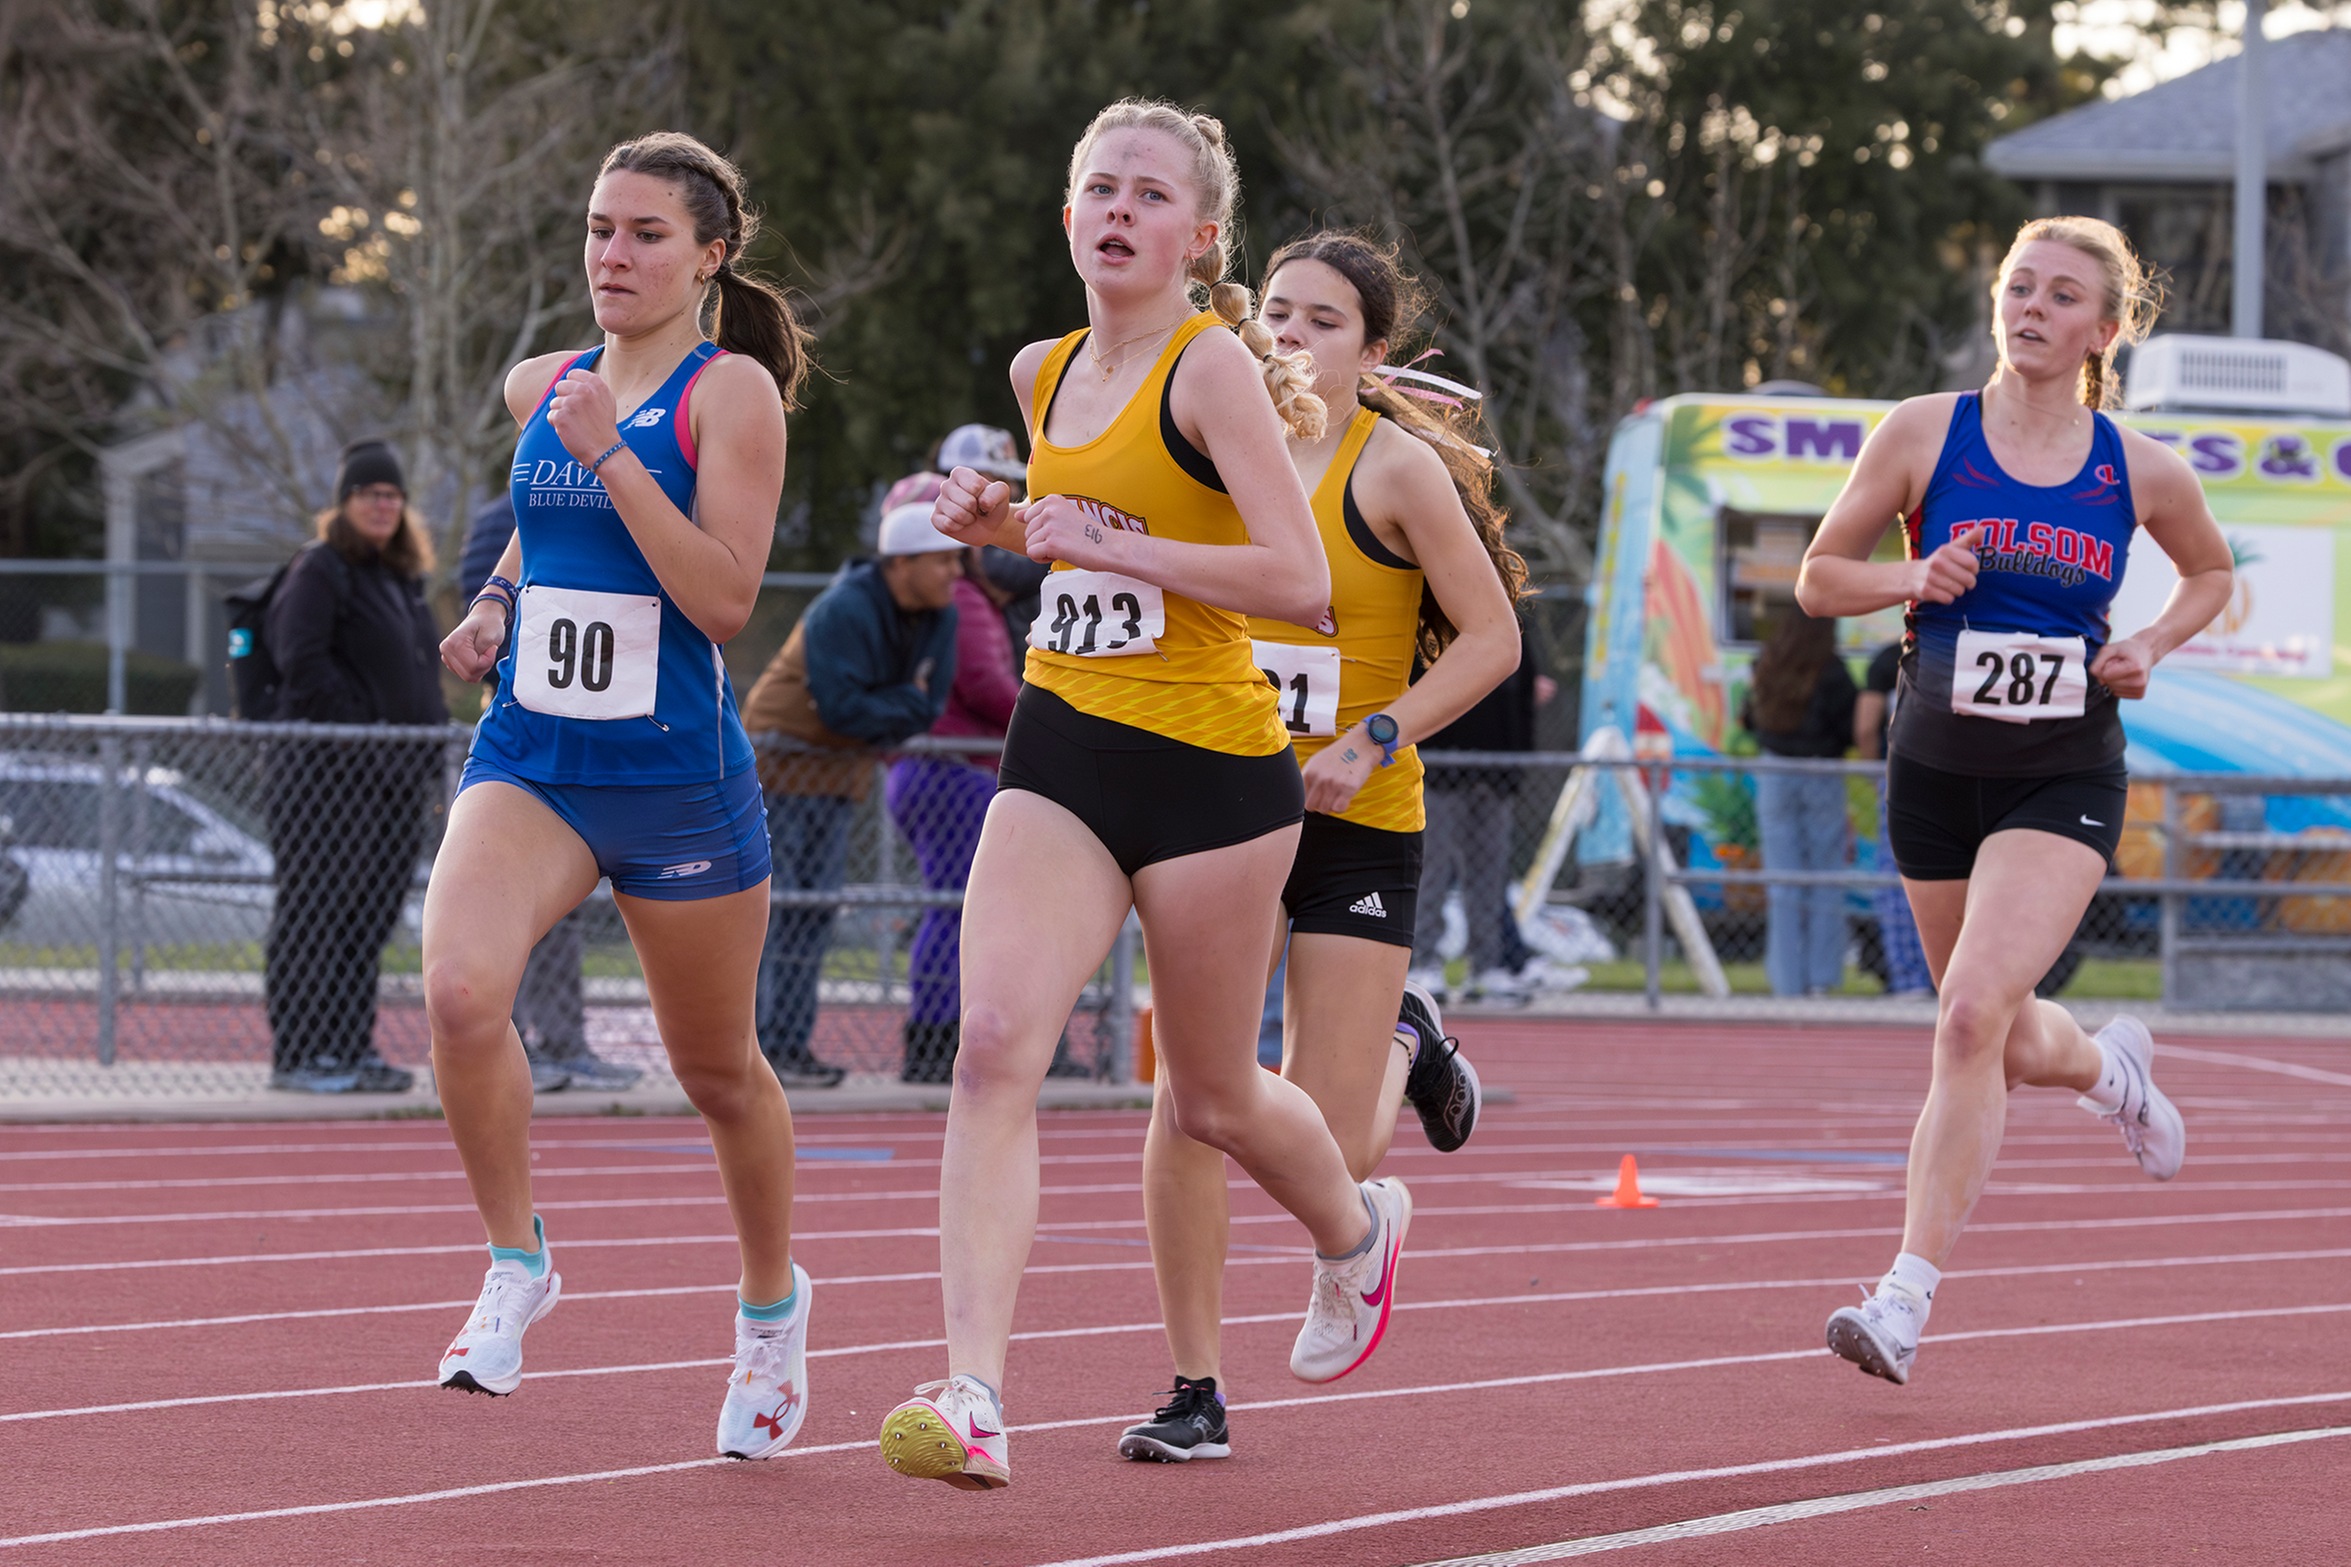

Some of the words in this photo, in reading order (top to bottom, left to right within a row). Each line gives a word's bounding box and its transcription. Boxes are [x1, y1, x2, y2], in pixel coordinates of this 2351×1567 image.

[528, 493, 566, 507] BLUE
[569, 493, 615, 510] DEVIL
[1084, 523, 1103, 544] 913
[1975, 545, 2086, 588] Bulldogs
[1047, 592, 1141, 655] 913
[547, 617, 615, 693] 90
[1972, 651, 2065, 706] 287
[1261, 668, 1311, 733] 1
[1348, 904, 1387, 918] adidas
